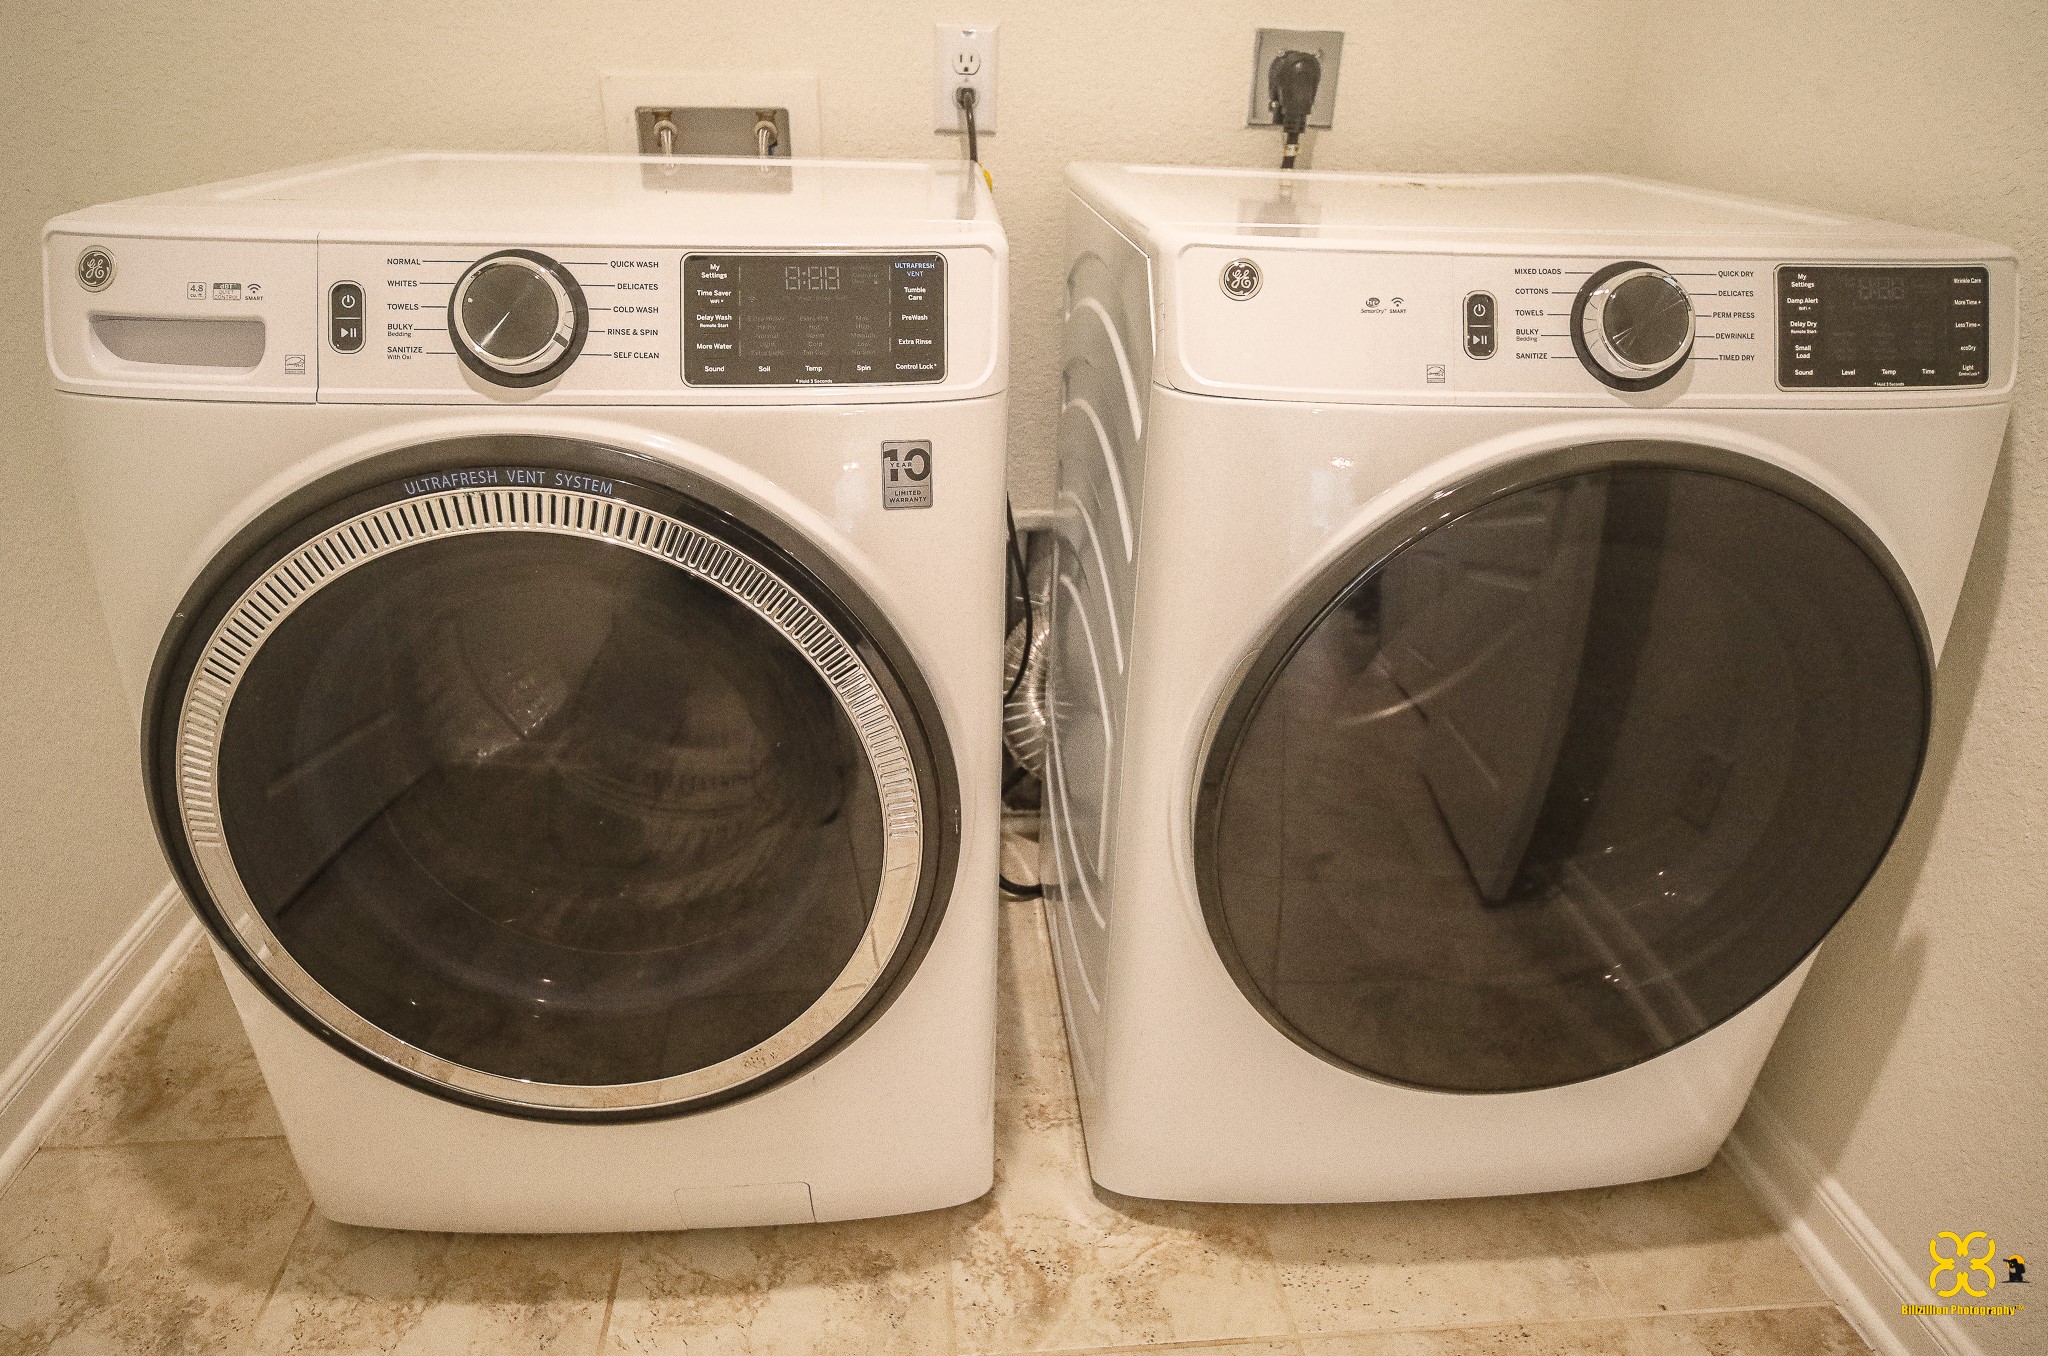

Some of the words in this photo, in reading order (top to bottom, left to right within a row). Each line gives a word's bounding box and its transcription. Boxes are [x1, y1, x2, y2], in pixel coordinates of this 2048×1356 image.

[610, 260, 635, 268] QUICK
[709, 263, 720, 271] My
[1718, 270, 1739, 278] QUICK
[190, 284, 204, 292] 4.8
[696, 314, 714, 322] Delay
[607, 328, 631, 336] RINSE
[883, 448, 931, 481] 10
[404, 470, 498, 495] ULTRAFRESH
[506, 470, 545, 484] VENT
[555, 473, 613, 495] SYSTEM
